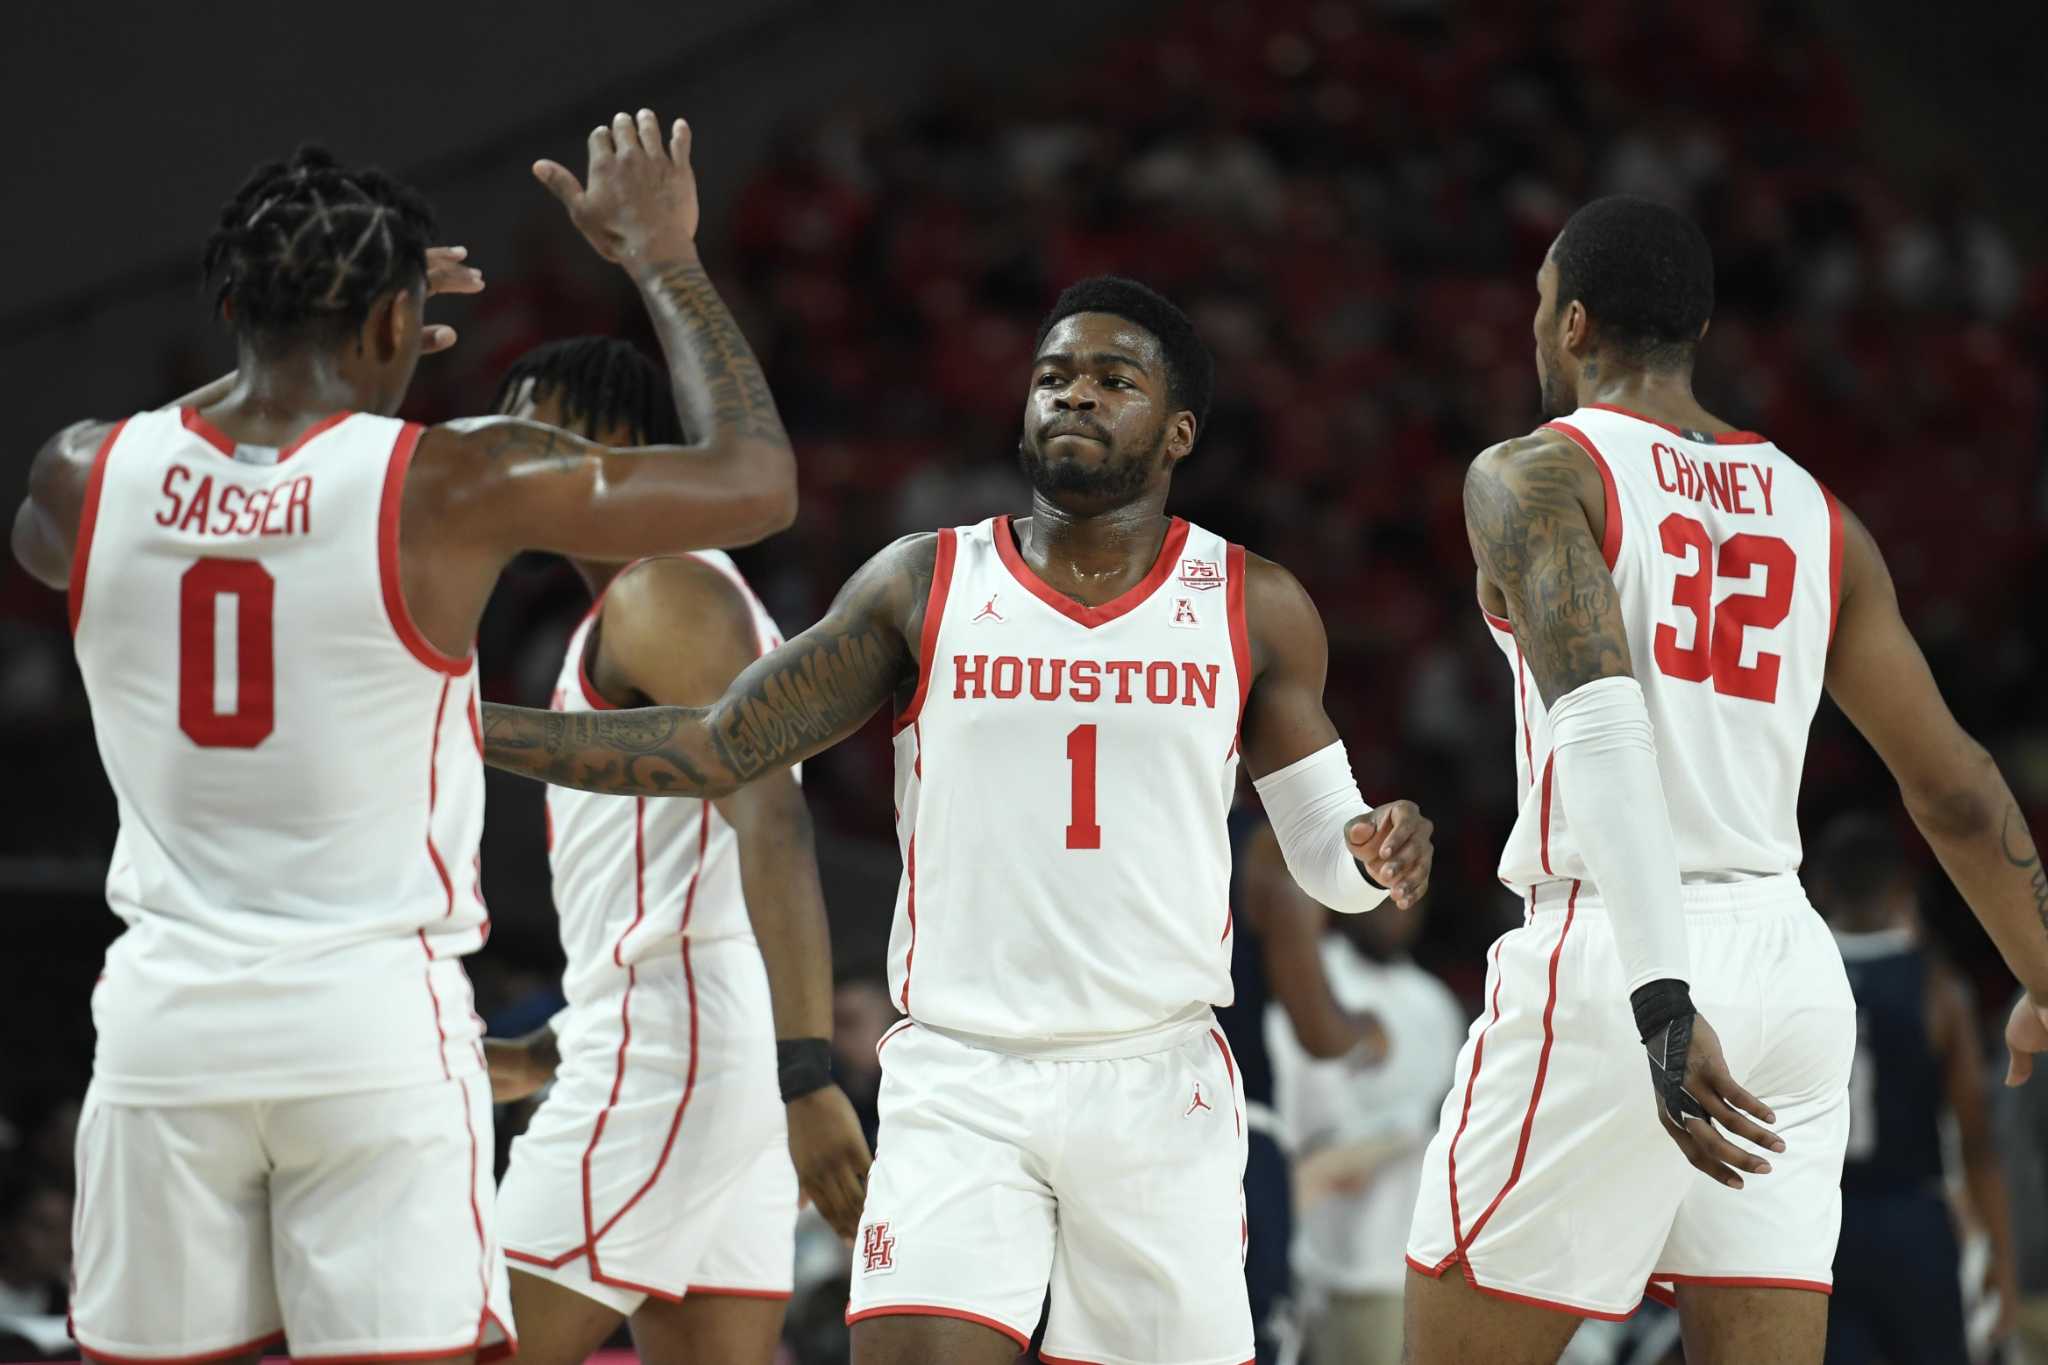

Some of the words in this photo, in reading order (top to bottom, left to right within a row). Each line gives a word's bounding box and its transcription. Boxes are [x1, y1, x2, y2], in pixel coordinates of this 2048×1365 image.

[155, 464, 313, 536] SASSER
[178, 556, 275, 749] 0
[1653, 512, 1797, 704] 32
[953, 655, 1220, 709] HOUSTON
[1065, 724, 1101, 849] 1
